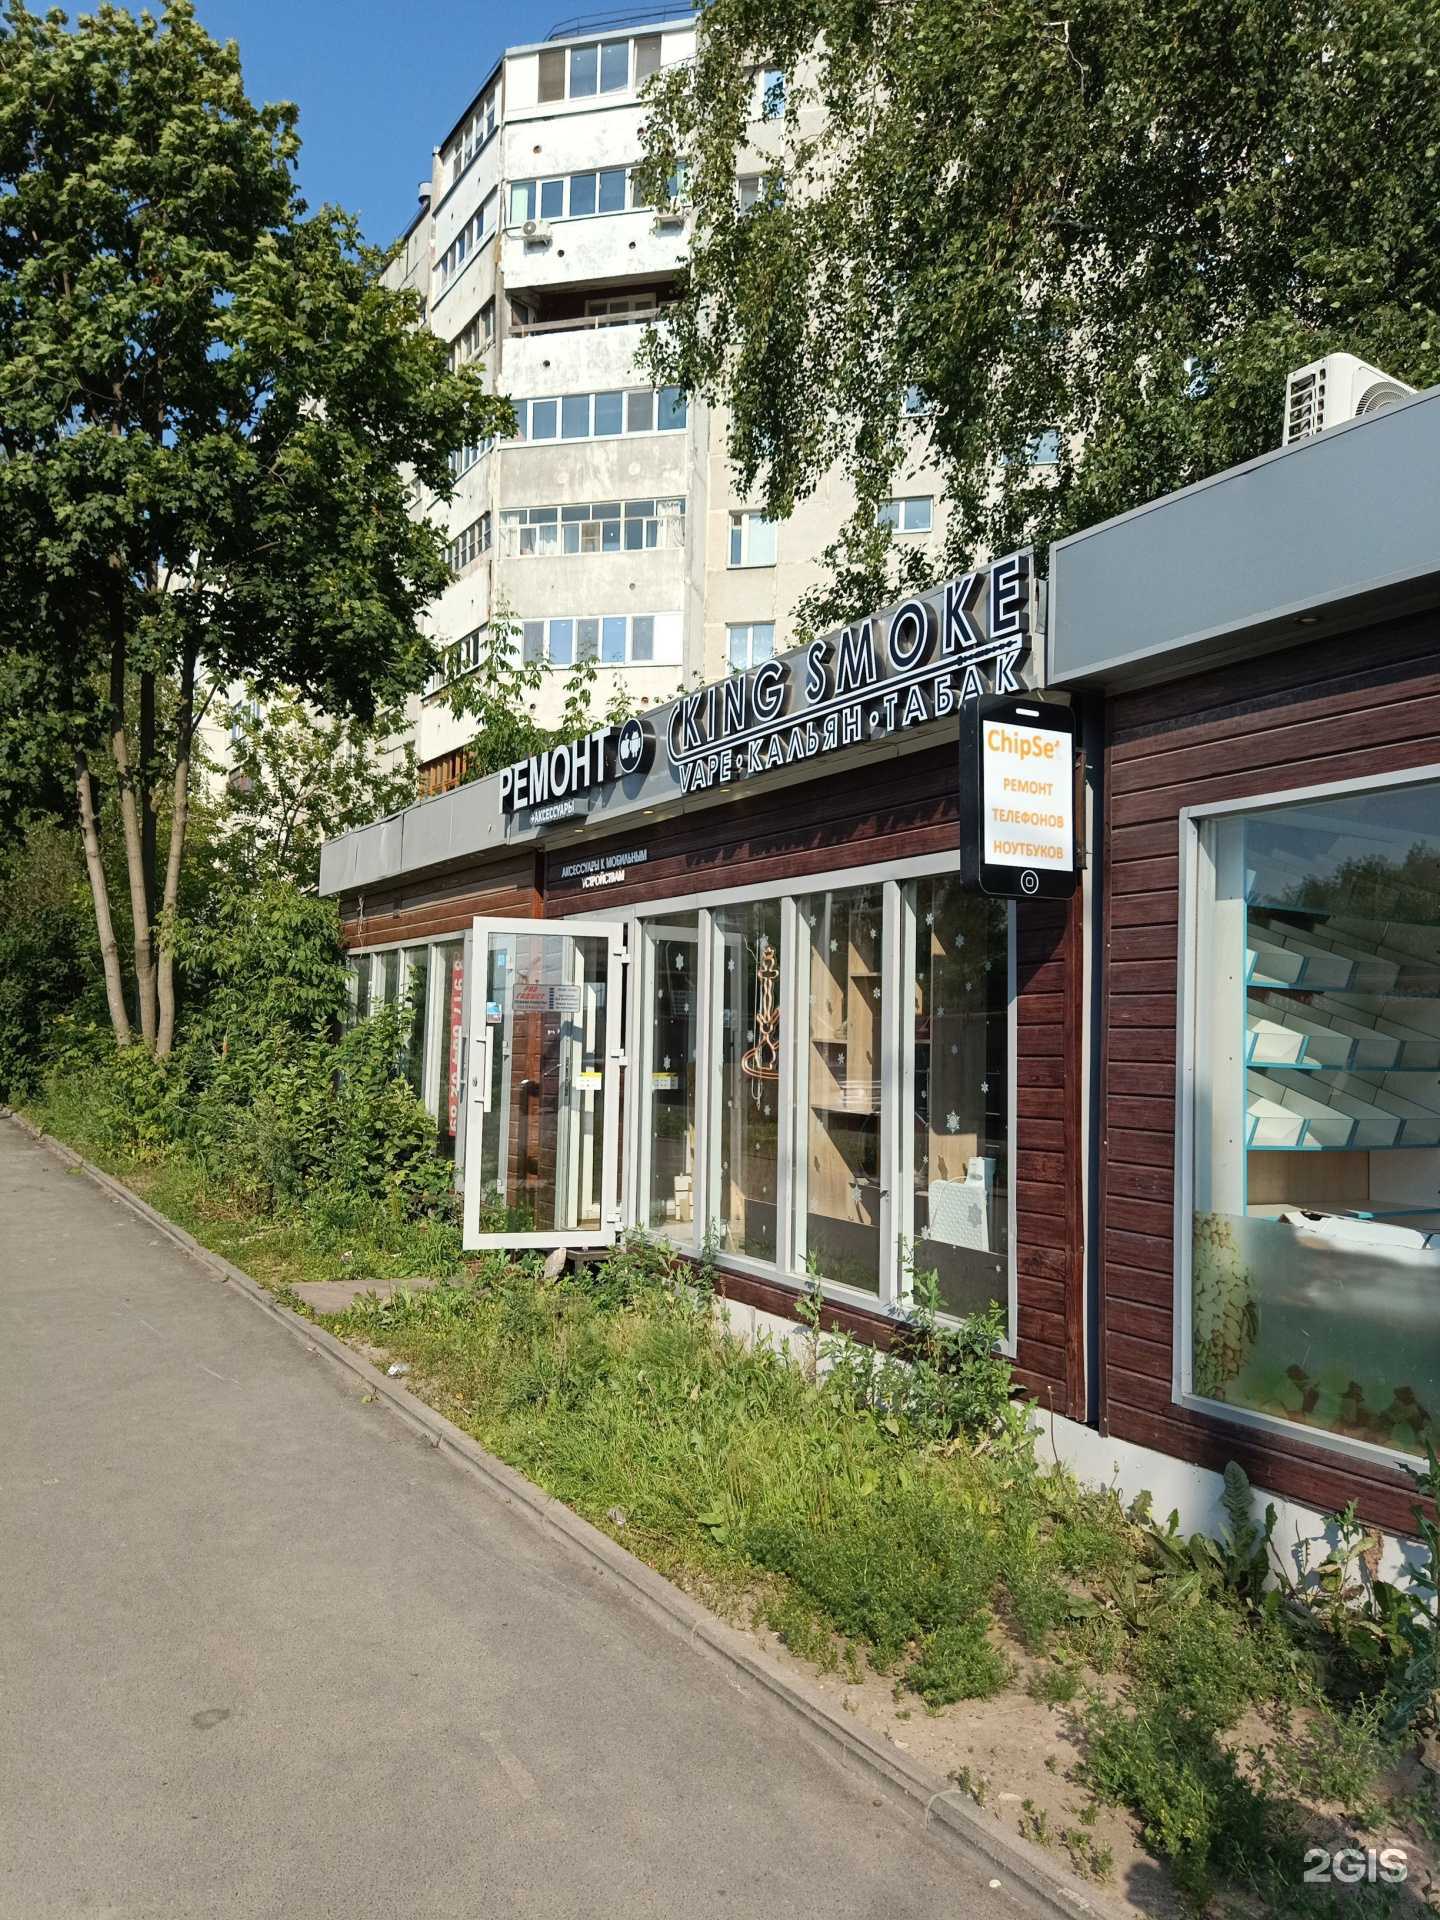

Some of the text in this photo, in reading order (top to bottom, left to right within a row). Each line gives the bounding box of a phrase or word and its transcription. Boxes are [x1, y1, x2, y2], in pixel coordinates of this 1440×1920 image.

[682, 555, 1020, 750] KING SMOKE
[678, 649, 1022, 793] VAPE КАЛЬЯН ТАБАК
[499, 726, 612, 814] РЕМОНТ
[1003, 777, 1054, 796] РЕМОНТ
[992, 808, 1065, 829] ТЕЛЕФОНОВ
[993, 840, 1064, 860] НОУТБУКОВ
